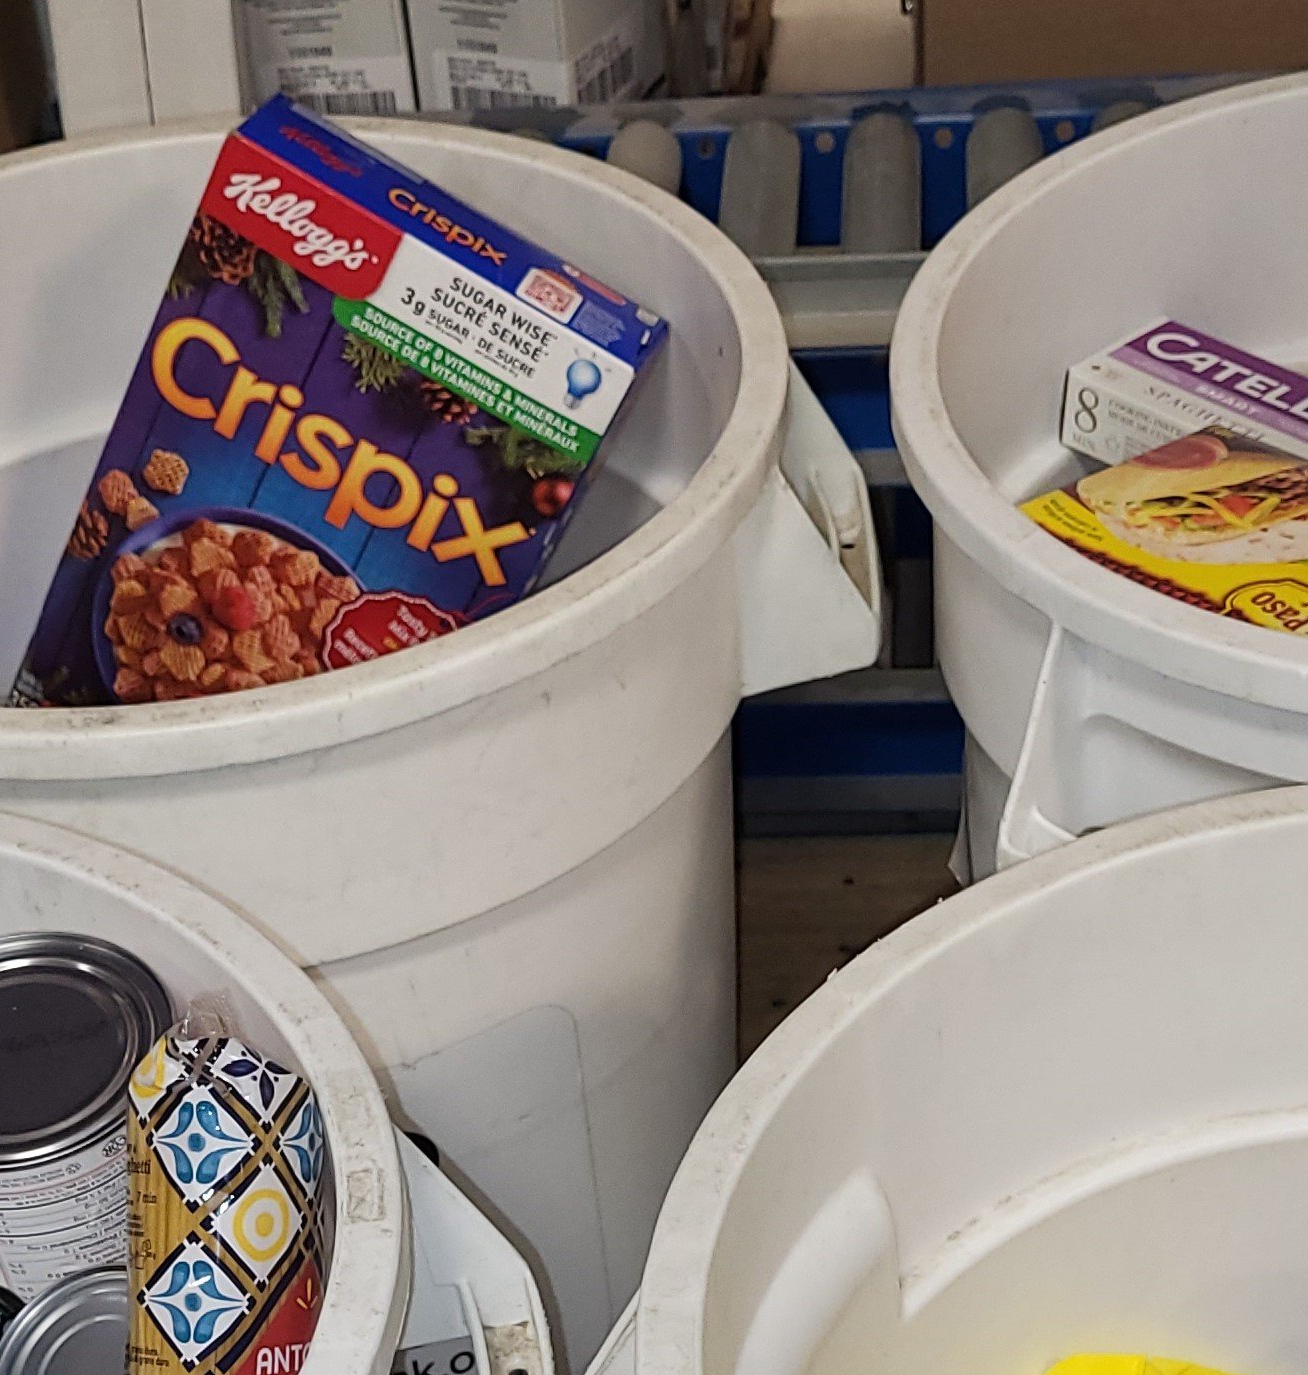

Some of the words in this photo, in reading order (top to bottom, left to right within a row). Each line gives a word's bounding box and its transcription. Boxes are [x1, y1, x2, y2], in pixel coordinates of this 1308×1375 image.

[223, 173, 379, 271] Kellogg's
[387, 188, 508, 267] Crispix
[428, 309, 470, 339] SUGAR
[477, 337, 495, 353] DE
[431, 288, 488, 327] SUCRÉ
[450, 277, 507, 319] SUGAR
[512, 312, 555, 347] WISE
[351, 316, 401, 352] SOURCE
[401, 344, 421, 363] DE
[430, 360, 497, 408] VITAMINES
[496, 400, 514, 417] ET
[364, 307, 416, 343] SOURCE
[414, 335, 434, 354] OF
[444, 351, 502, 396] VITAMINS
[514, 392, 579, 438] MINERALS
[1074, 386, 1100, 434] 8
[151, 316, 537, 587] Crispix
